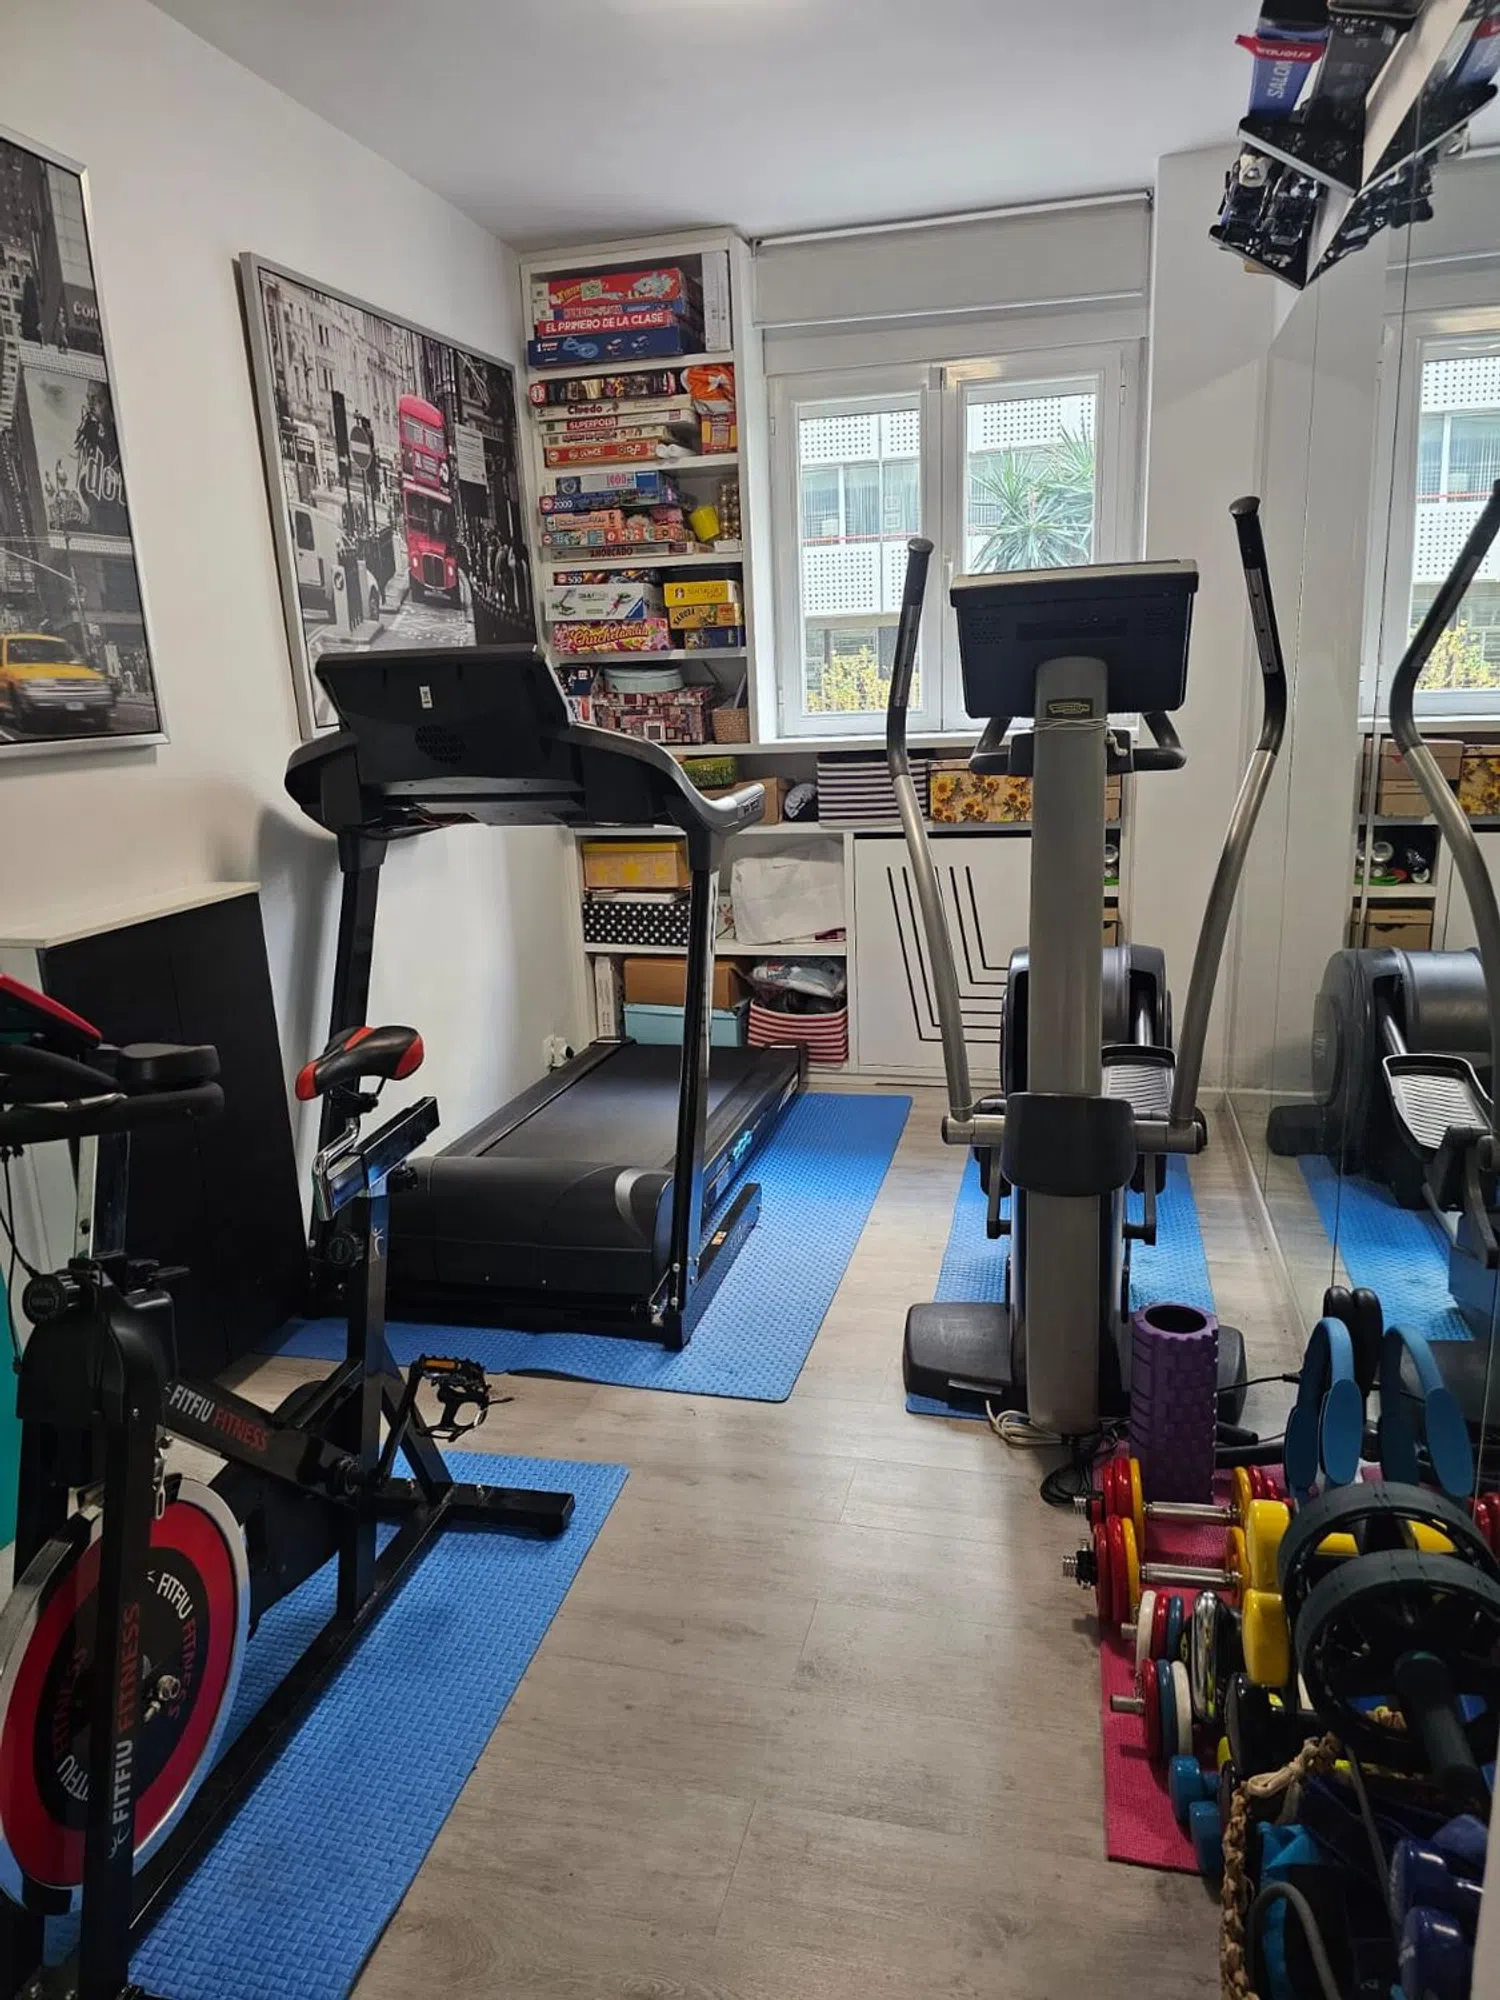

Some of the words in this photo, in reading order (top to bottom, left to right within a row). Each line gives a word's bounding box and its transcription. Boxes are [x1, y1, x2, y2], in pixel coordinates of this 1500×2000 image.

[545, 322, 556, 334] EL
[558, 318, 600, 333] PRIMERO
[602, 316, 615, 329] DE
[616, 315, 630, 328] LA
[630, 312, 664, 325] CLASE
[567, 403, 603, 416] Cluedo
[553, 500, 573, 510] 2000
[567, 575, 583, 585] 500
[168, 1384, 216, 1424] FITFIU
[212, 1406, 269, 1452] FITNESS
[156, 1571, 194, 1620] FITFIU
[115, 1601, 141, 1735] FITNESS
[55, 1753, 90, 1802] ITFIU
[112, 1739, 135, 1826] FITFIU
